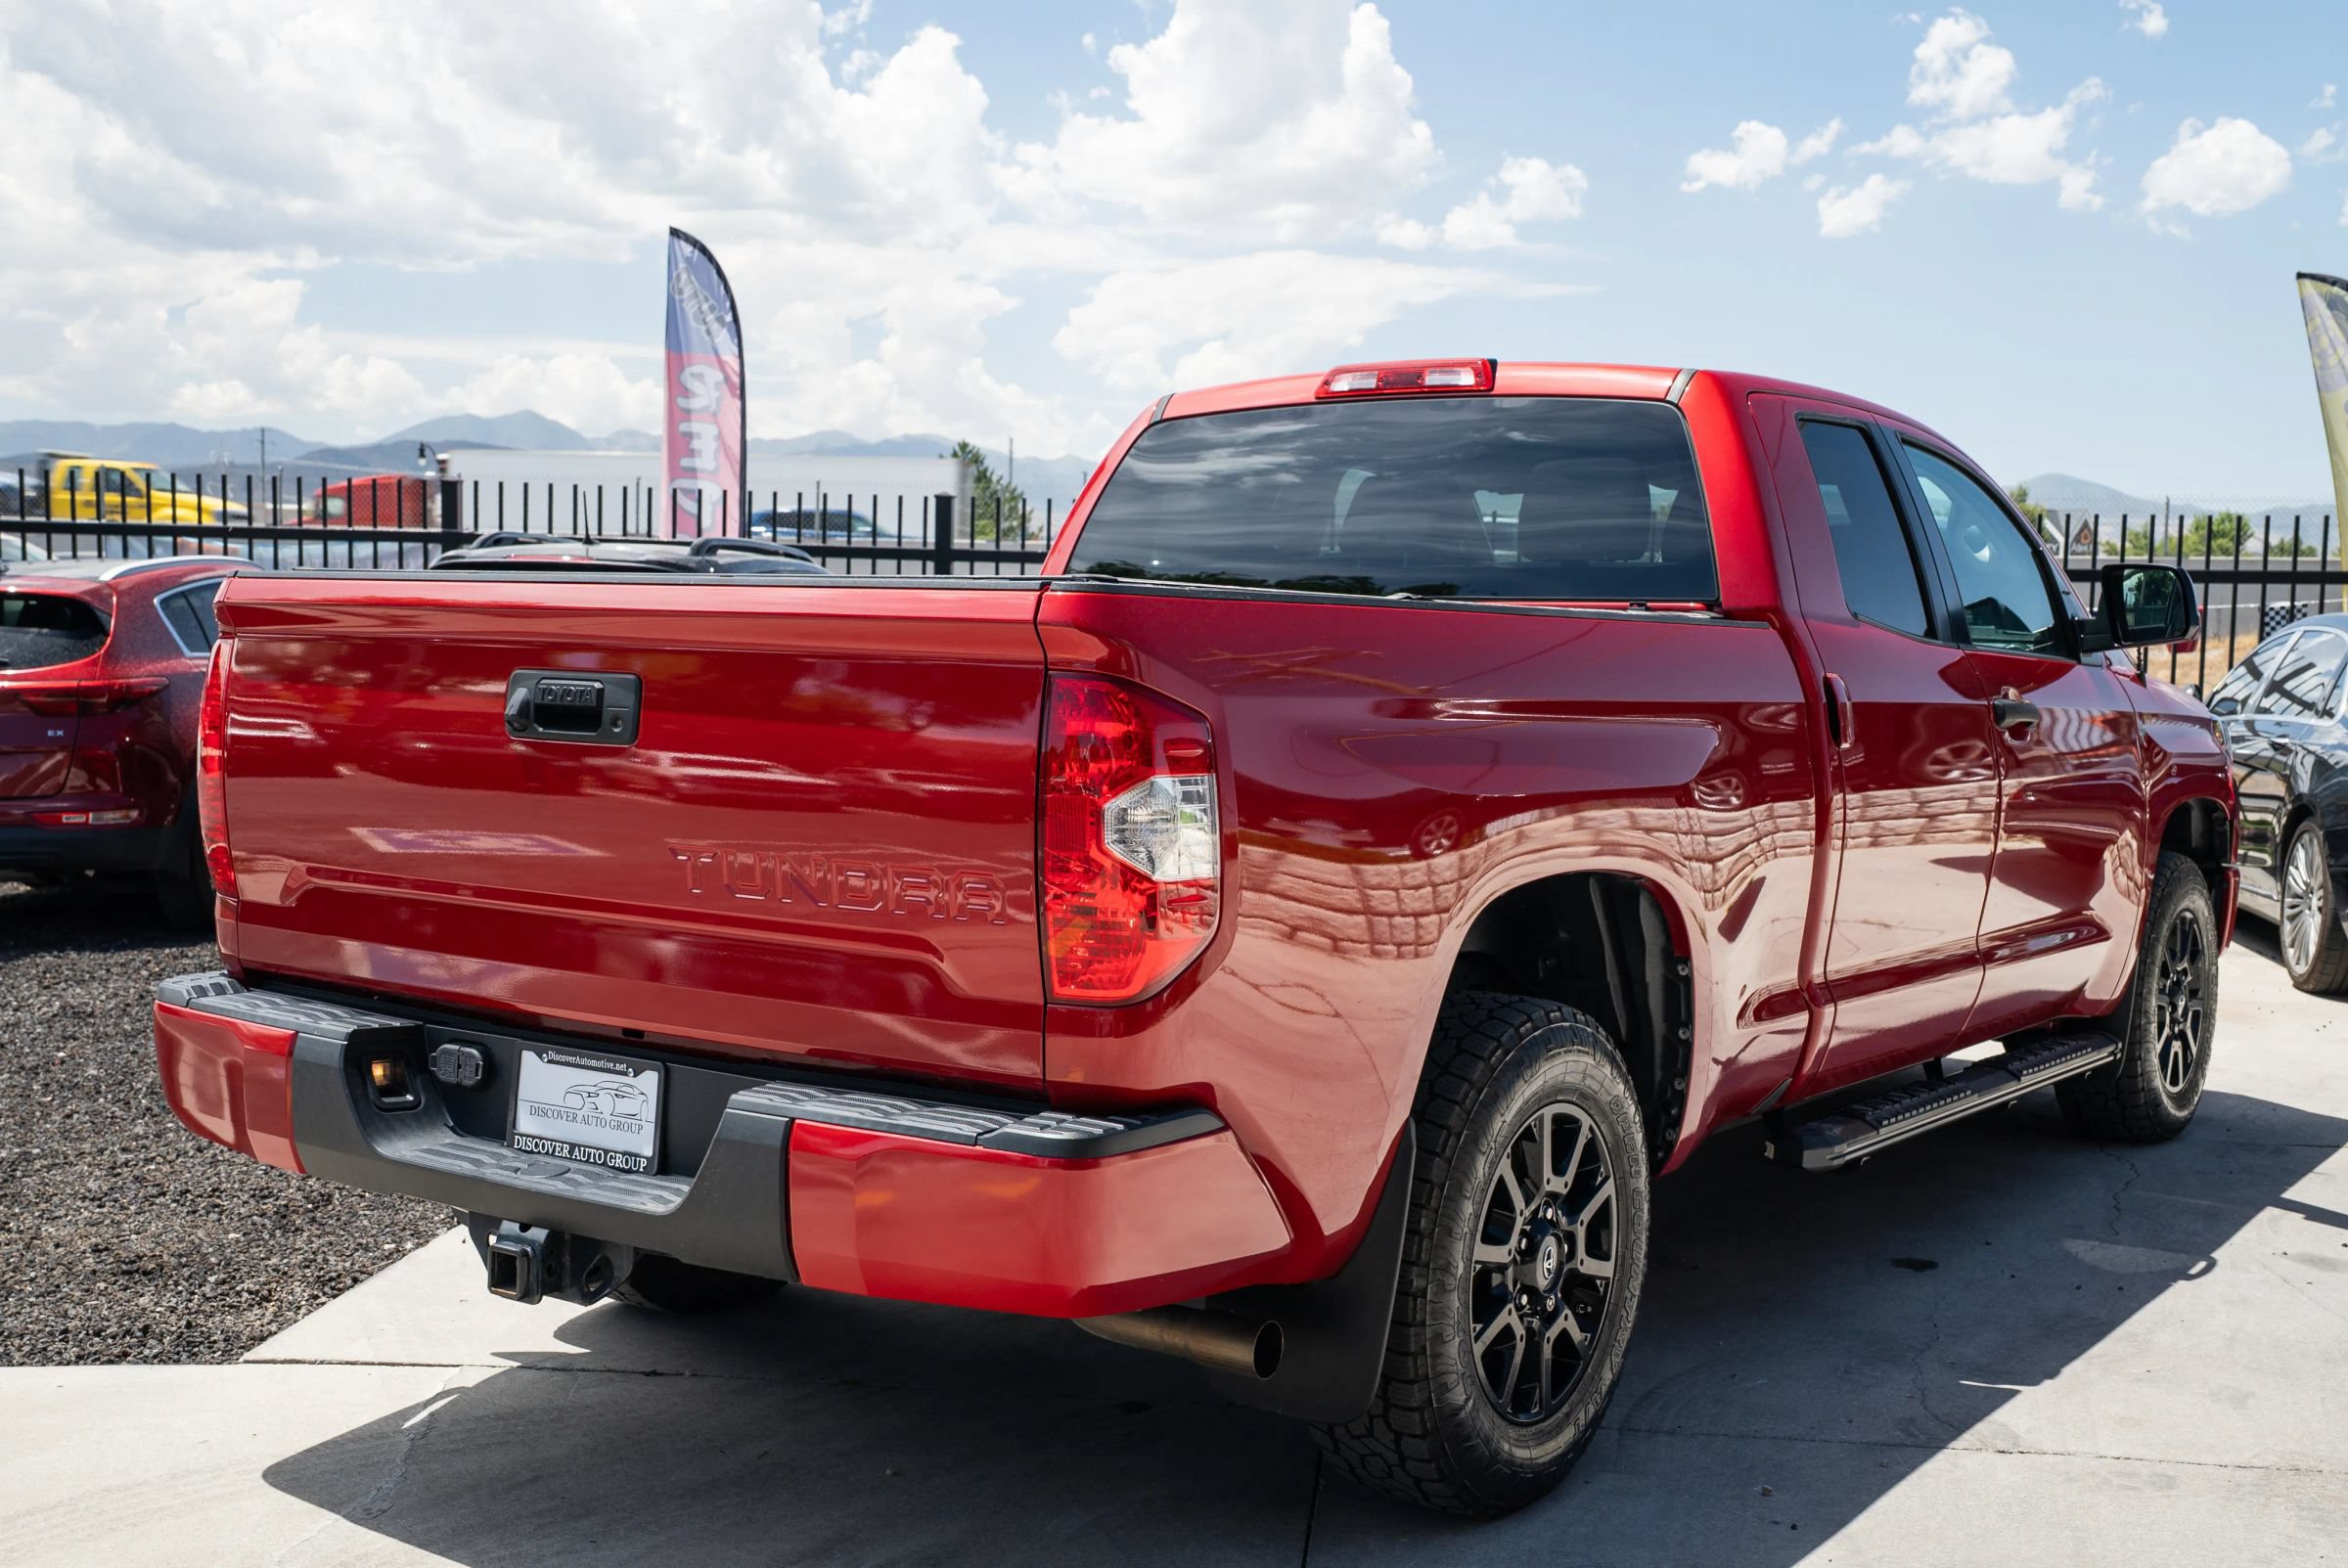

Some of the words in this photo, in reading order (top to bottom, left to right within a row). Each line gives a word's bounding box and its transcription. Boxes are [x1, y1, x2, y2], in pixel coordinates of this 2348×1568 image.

[538, 686, 594, 703] TOYOTA
[668, 843, 1006, 924] TUNDRA
[548, 1051, 627, 1072] DiscoverAutomotive.net
[529, 1104, 578, 1124] DISCOVER
[580, 1114, 608, 1129] AUTO
[609, 1119, 644, 1135] GROUP
[514, 1135, 570, 1158] DISCOVER
[571, 1146, 605, 1164] AUTO
[607, 1152, 648, 1172] GROUP
[1609, 1095, 1642, 1179] OPEN
